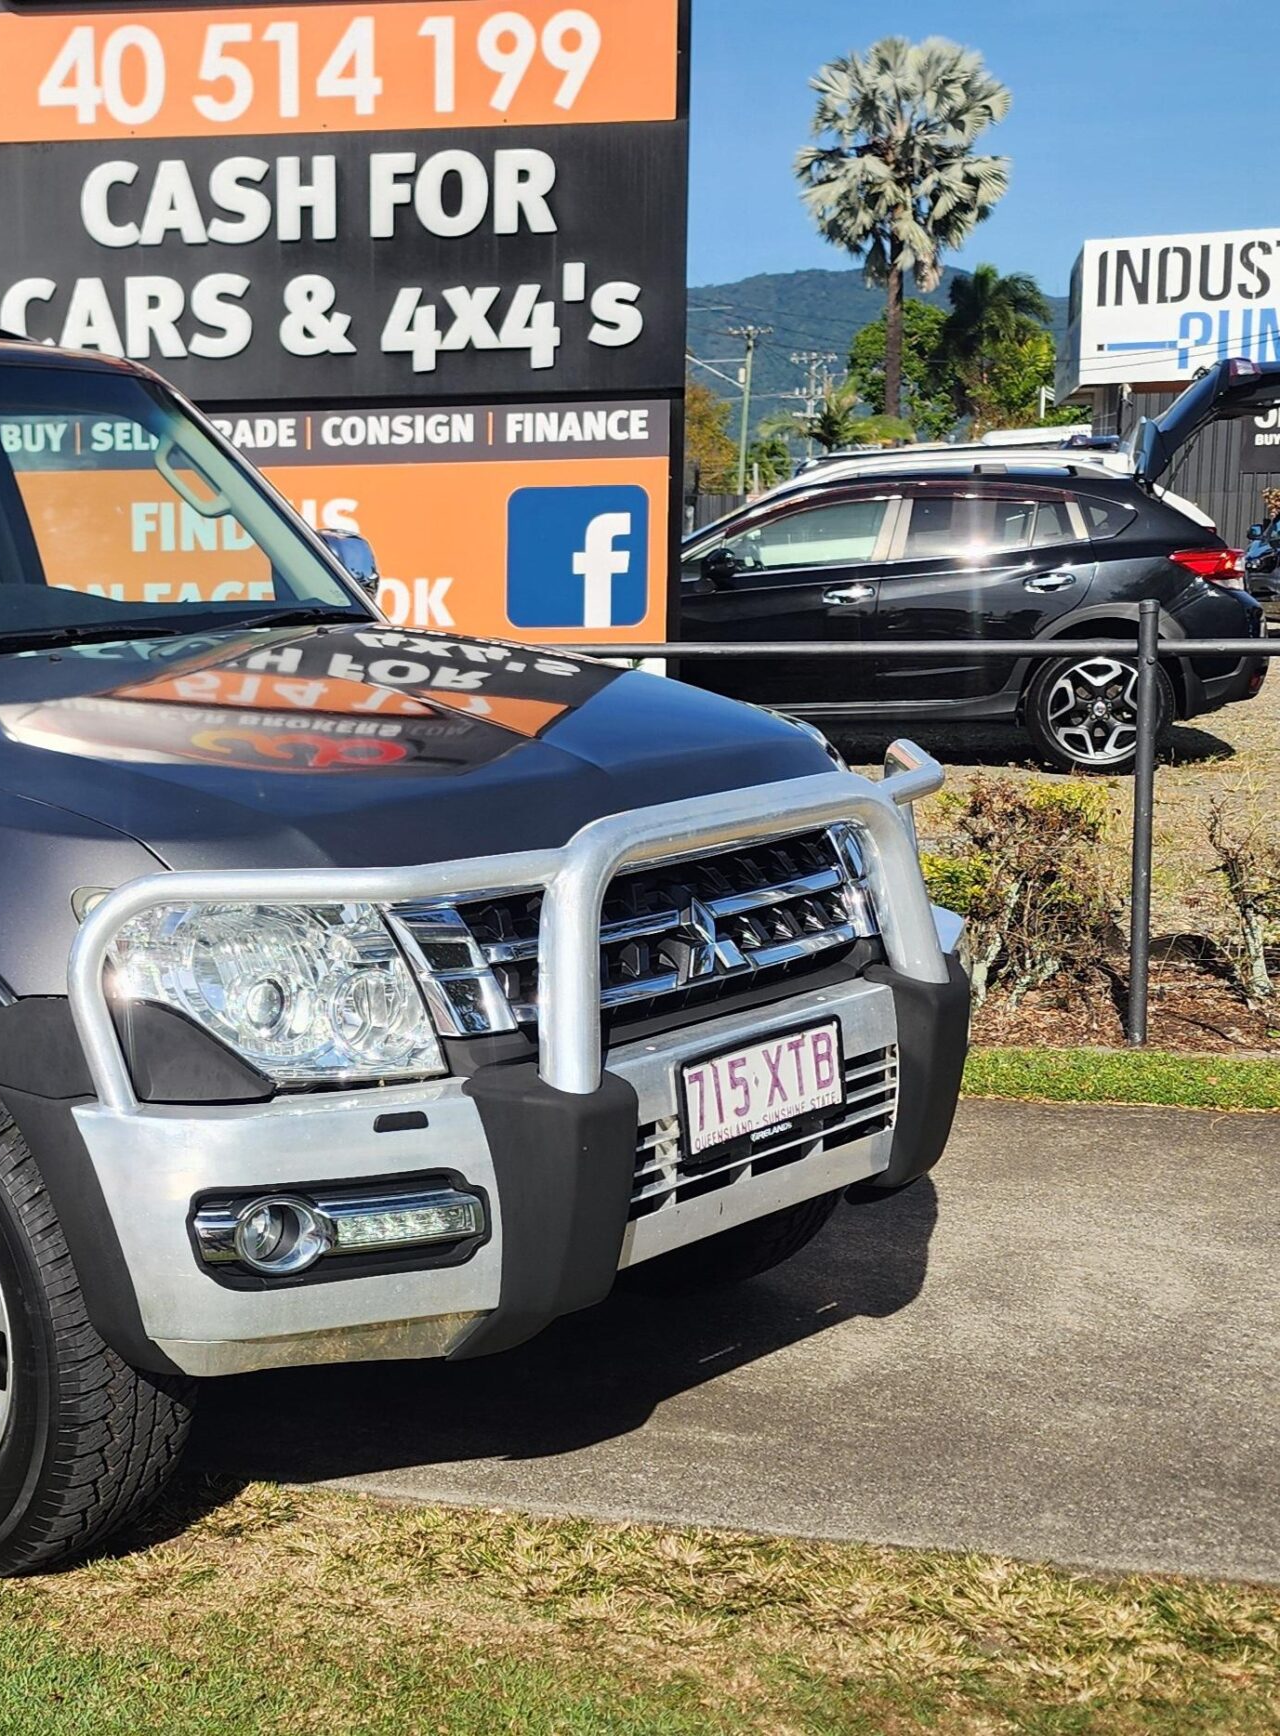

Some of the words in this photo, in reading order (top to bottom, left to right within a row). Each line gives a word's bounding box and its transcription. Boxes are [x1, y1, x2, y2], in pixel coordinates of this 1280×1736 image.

[38, 24, 165, 125] 40
[192, 16, 383, 121] 514
[417, 9, 602, 113] 199
[80, 154, 338, 248] CASH
[369, 148, 558, 240] FOR
[0, 272, 253, 360] CARS
[279, 273, 356, 357] &
[1097, 238, 1280, 307] INDUS
[0, 422, 68, 453] BUY
[90, 421, 159, 452] SEL
[209, 417, 297, 449] RADE
[322, 413, 475, 447] CONSIGN
[505, 409, 649, 444] FINANCE
[688, 1057, 751, 1131] 715
[762, 1032, 835, 1107] XTB
[762, 1102, 806, 1126] SUNSHINE
